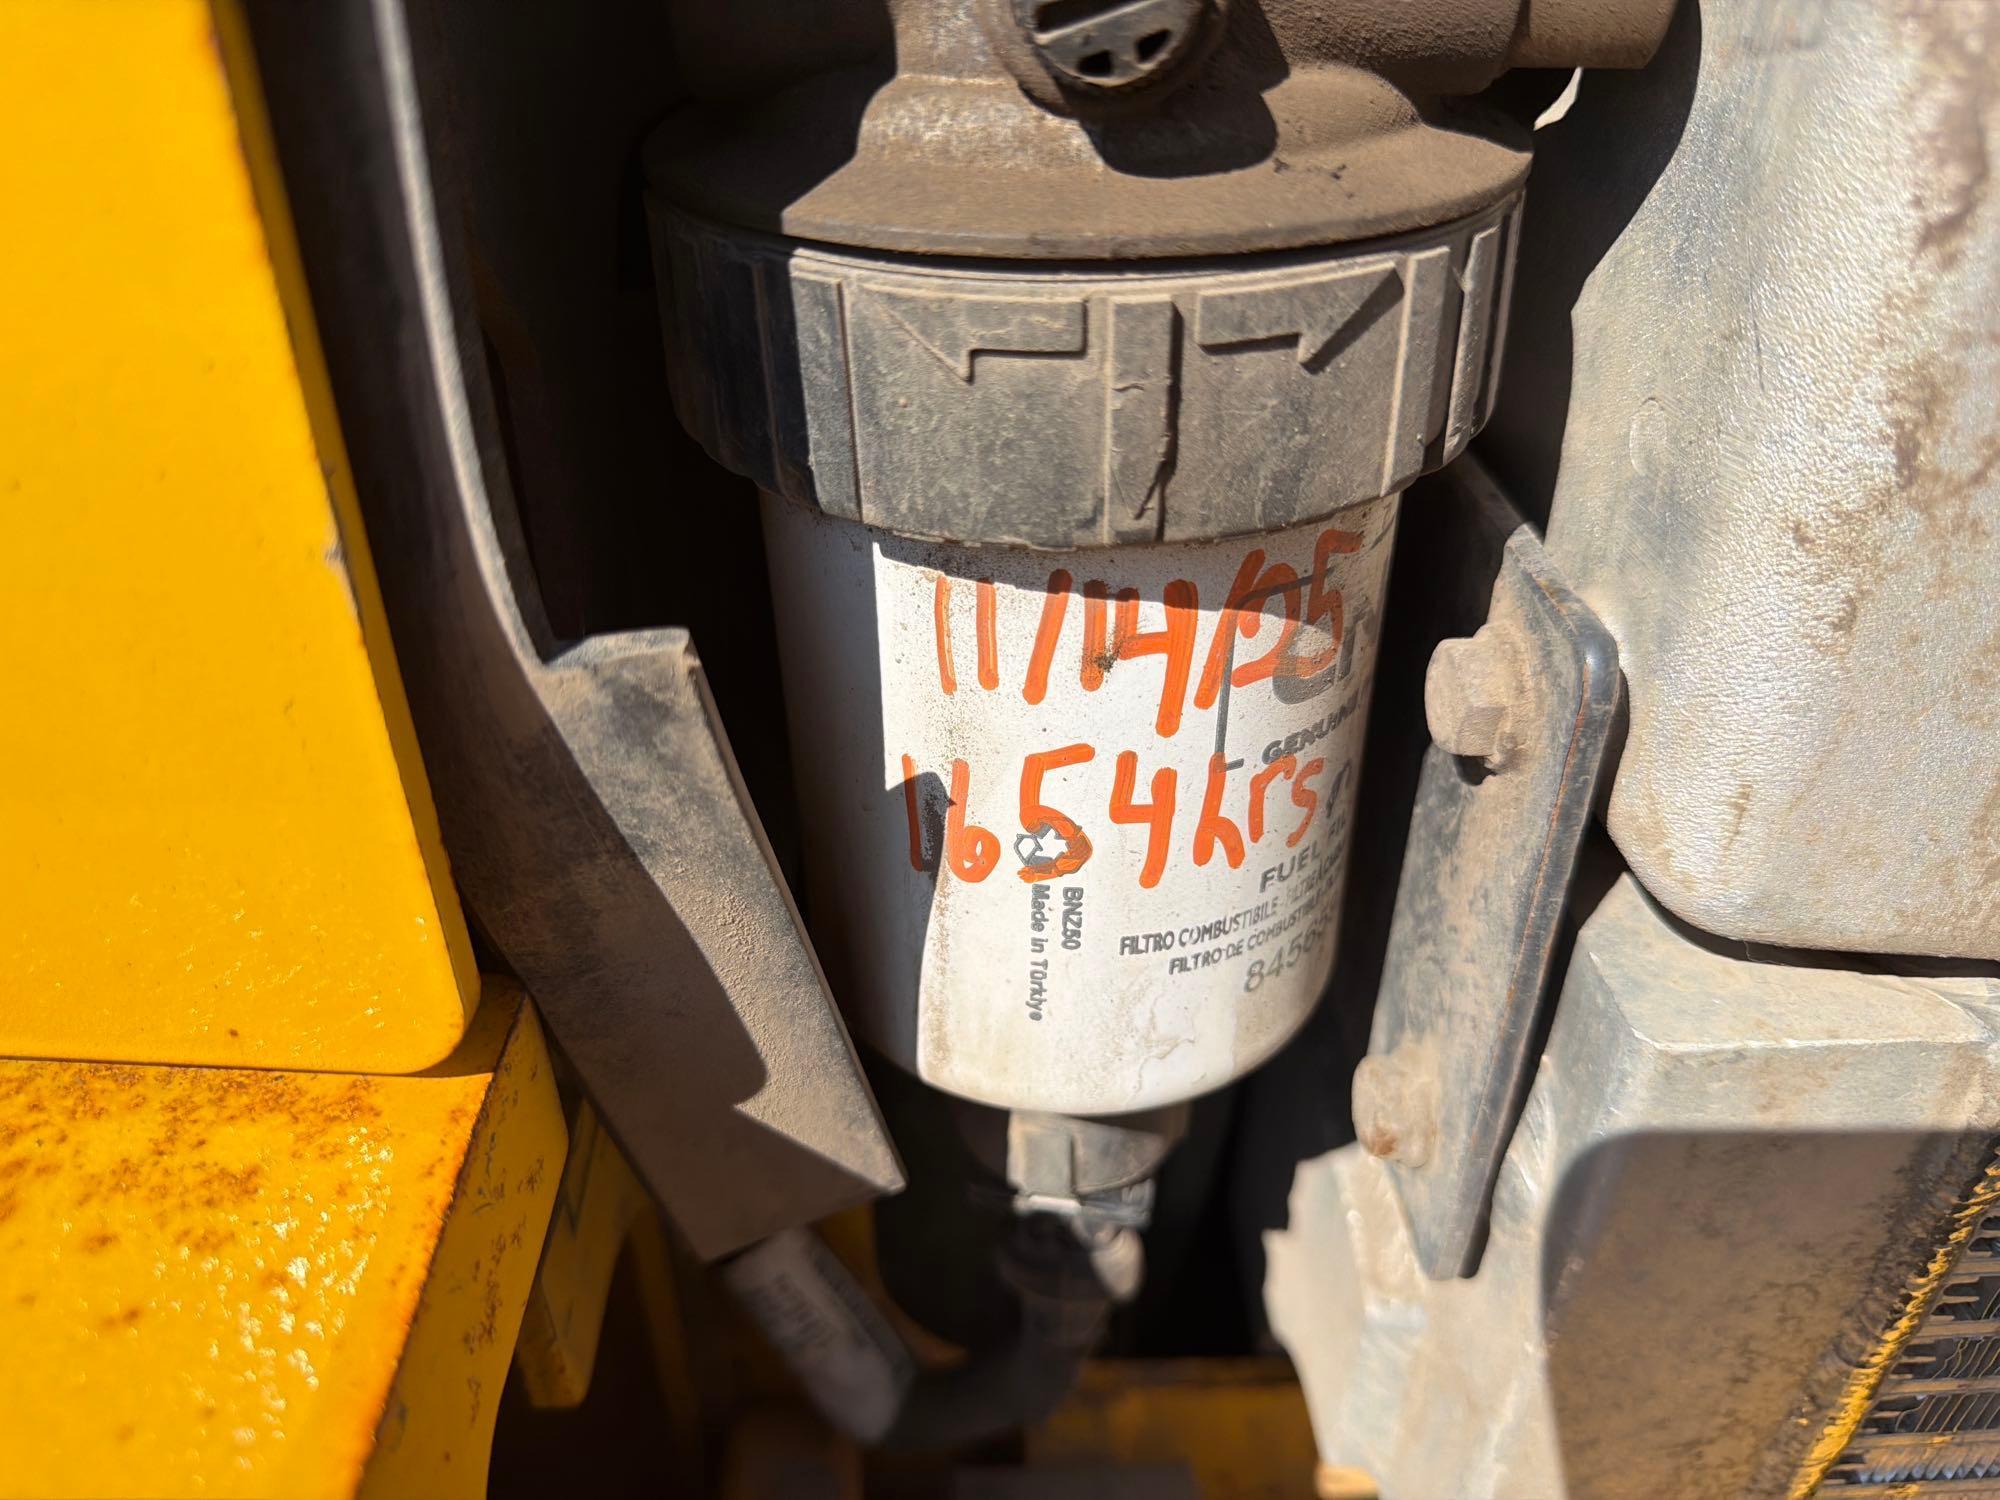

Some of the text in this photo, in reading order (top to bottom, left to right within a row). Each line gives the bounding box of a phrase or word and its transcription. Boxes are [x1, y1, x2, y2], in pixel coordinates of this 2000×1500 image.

[1259, 838, 1321, 893] FUEL
[1030, 883, 1051, 932] Made
[1119, 930, 1175, 956] FILTRO
[1178, 896, 1279, 948] COMBUSTIBILE
[1030, 936, 1049, 953] in
[1168, 947, 1222, 976] FILTRO
[1225, 938, 1245, 960] DE
